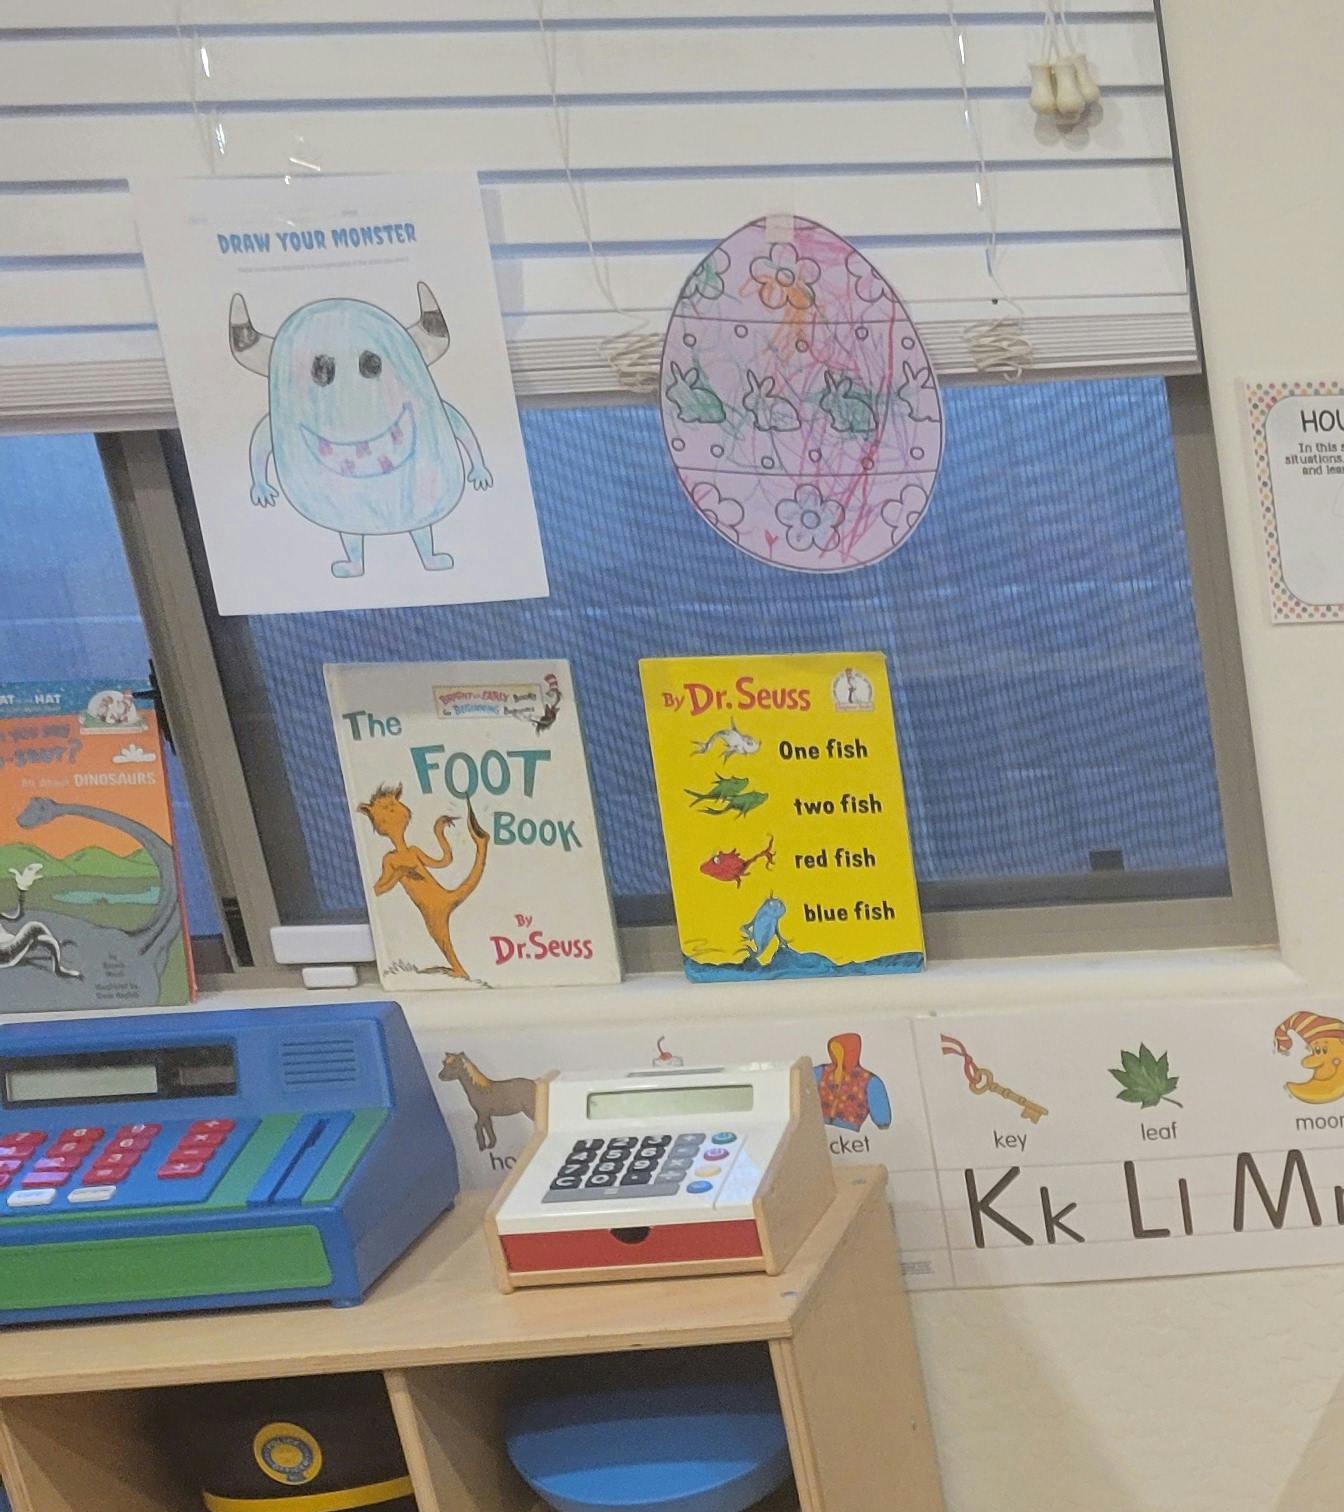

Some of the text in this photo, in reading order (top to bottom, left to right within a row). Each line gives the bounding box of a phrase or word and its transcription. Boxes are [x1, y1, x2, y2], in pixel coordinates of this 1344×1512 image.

[217, 222, 417, 254] DRAW YOUR MONSTER
[1298, 442, 1313, 453] In
[1315, 440, 1337, 452] this
[1302, 464, 1322, 475] and
[35, 694, 61, 704] HAT
[662, 676, 811, 716] By Dr. Seuss
[342, 710, 402, 741] The
[779, 738, 868, 760] One fish
[73, 772, 157, 787] DINOSAURS
[410, 744, 551, 800] FOOT
[793, 794, 882, 816] two fish
[493, 811, 583, 852] BOOK
[794, 847, 876, 869] red fish
[514, 913, 533, 928] By
[804, 901, 895, 923] blue fish
[489, 931, 593, 966] Dr. Seuss
[830, 1135, 870, 1156] cket
[993, 1129, 1028, 1152] key
[1140, 1122, 1178, 1142] leaf
[571, 1148, 656, 1161] 4 5 6
[565, 1160, 650, 1174] 7 8 9
[556, 1176, 575, 1187] C
[964, 1165, 1086, 1249] Kk
[1123, 1160, 1194, 1239] Ll
